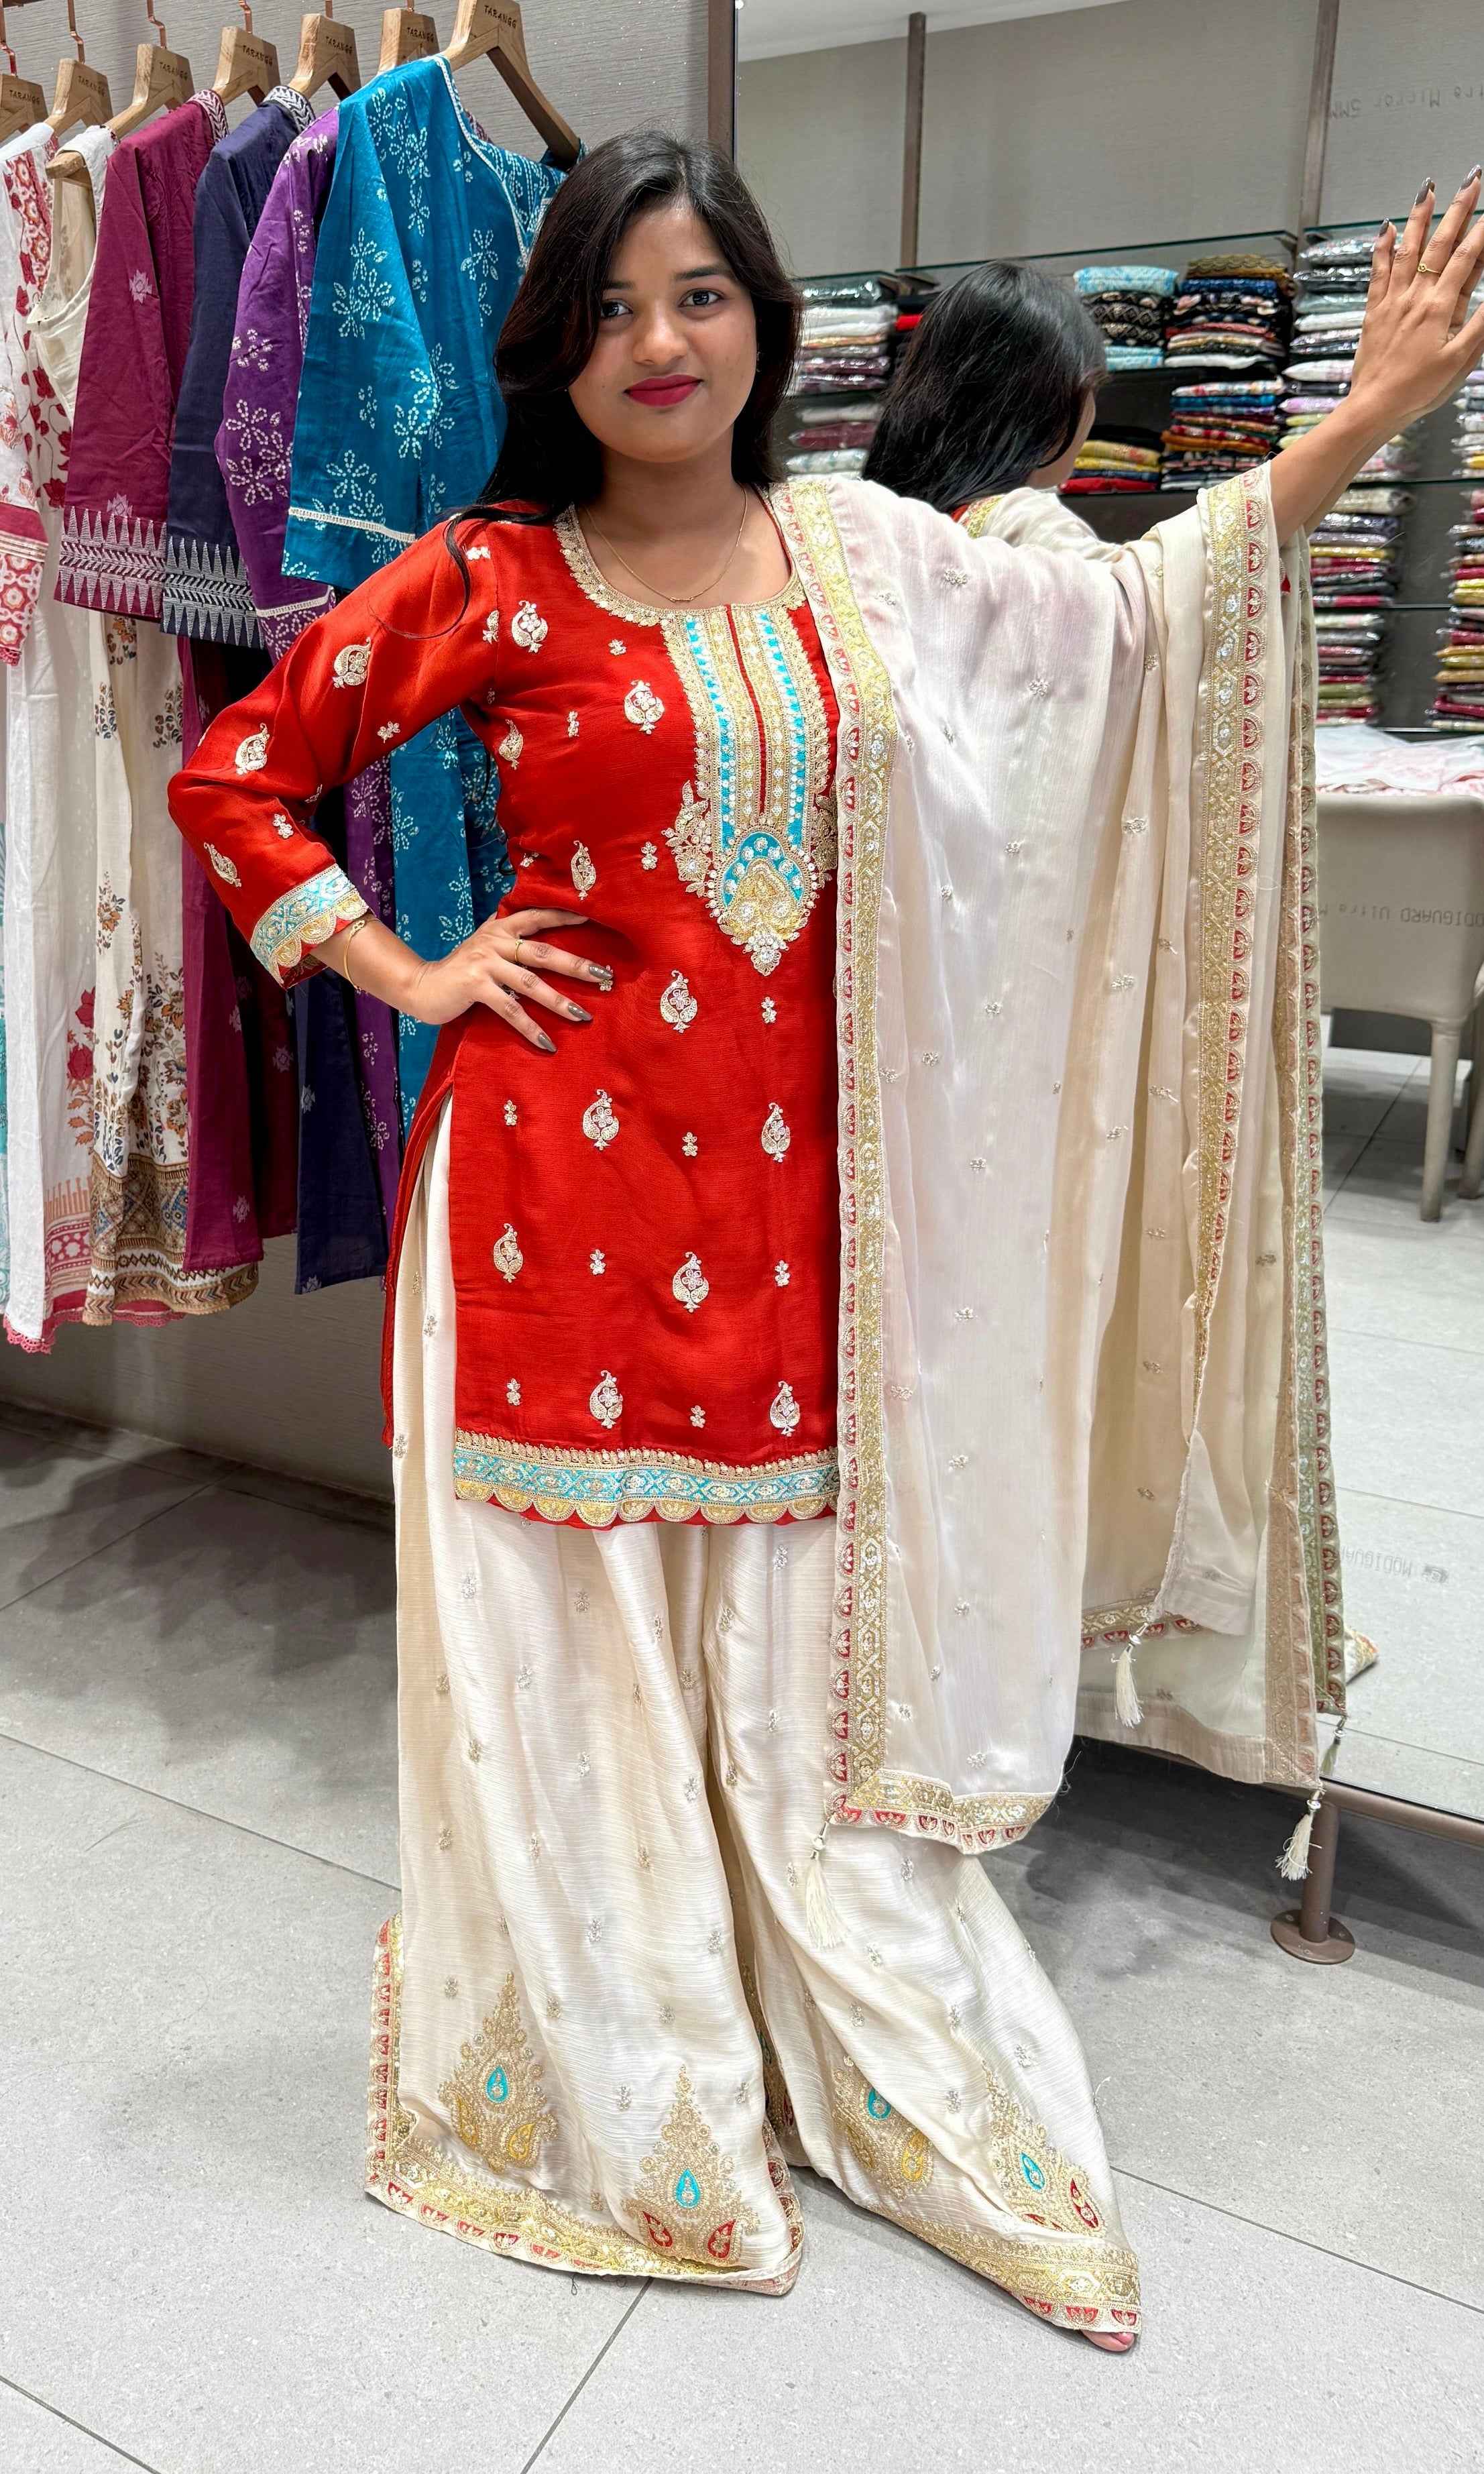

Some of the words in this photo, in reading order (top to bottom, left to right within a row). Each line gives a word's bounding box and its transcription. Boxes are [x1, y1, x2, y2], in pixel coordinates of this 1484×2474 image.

[484, 5, 517, 29] TARANGG
[406, 27, 435, 43] TARANGG
[325, 36, 353, 55] TARANGG
[241, 45, 273, 67] TARANGG
[159, 62, 188, 81] TARANGG
[78, 75, 105, 97] TARANGG
[9, 89, 40, 105] TARANGG
[1374, 89, 1440, 108] Mirror
